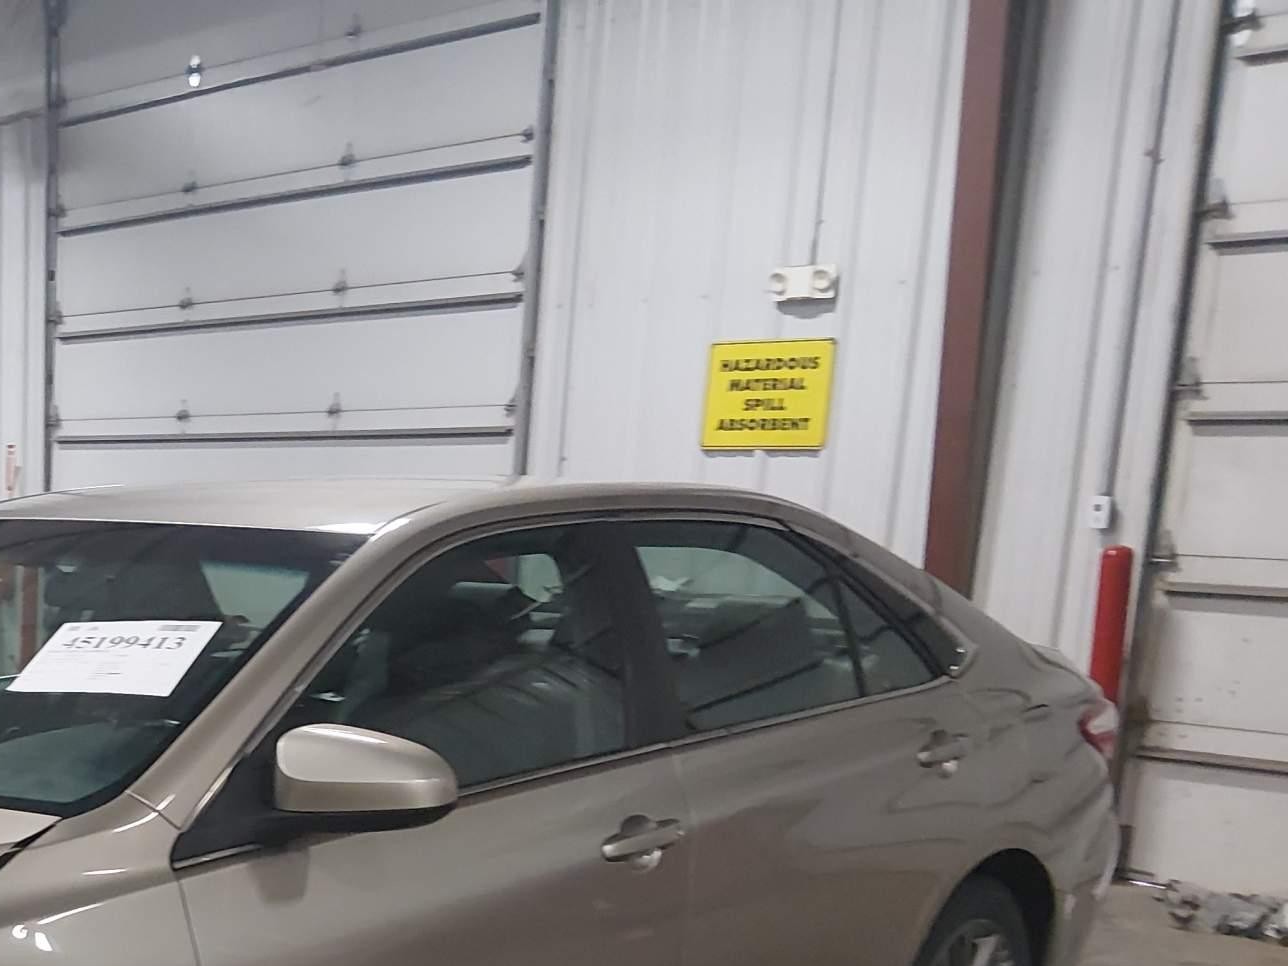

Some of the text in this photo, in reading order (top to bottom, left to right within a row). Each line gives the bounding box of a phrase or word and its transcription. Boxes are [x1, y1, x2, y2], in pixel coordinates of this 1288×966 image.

[720, 356, 821, 372] HAZARDOUS
[728, 377, 807, 391] MATERIAL
[742, 398, 786, 411] SPILL
[715, 417, 811, 431] ABSORBENT
[62, 635, 187, 651] 45199413
